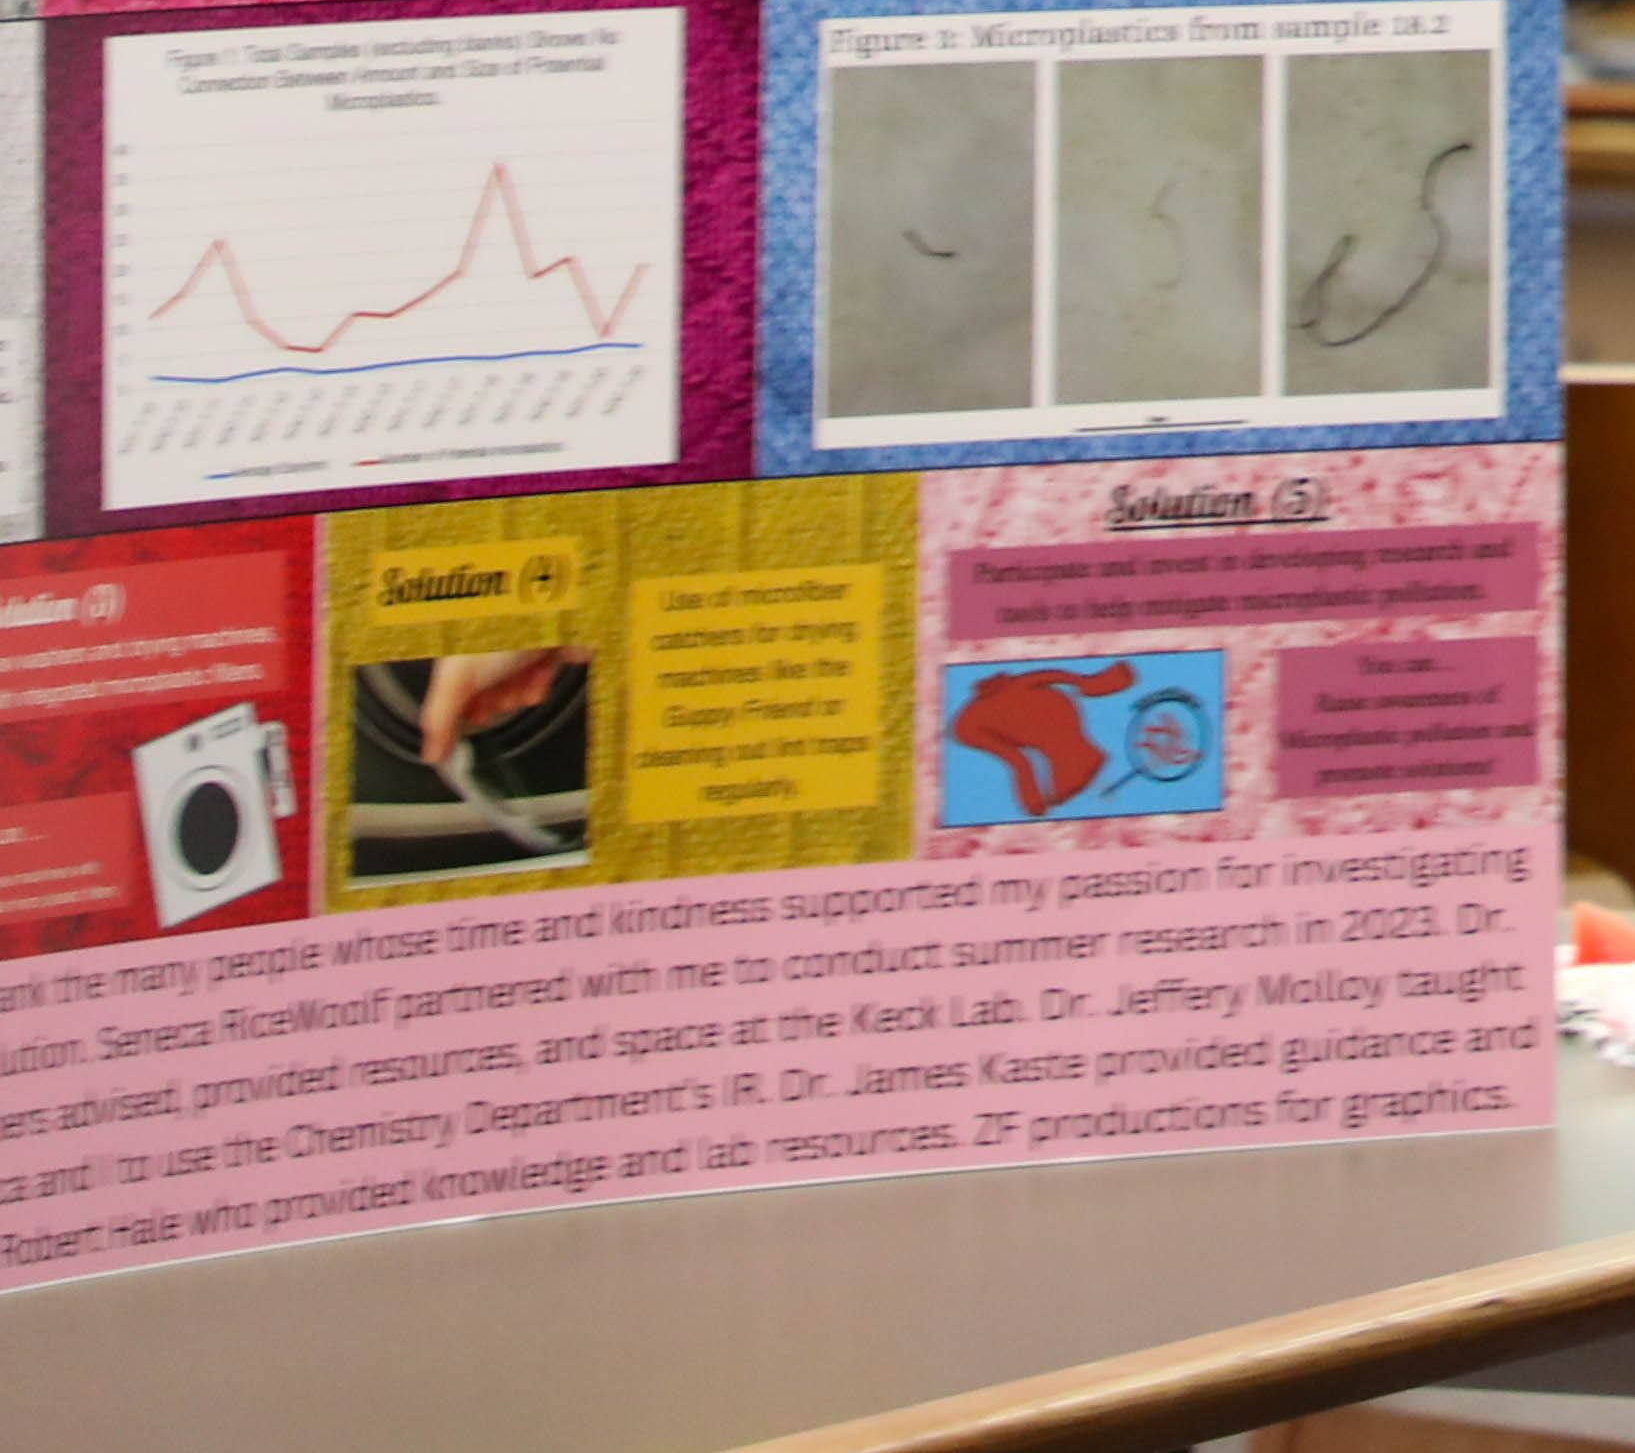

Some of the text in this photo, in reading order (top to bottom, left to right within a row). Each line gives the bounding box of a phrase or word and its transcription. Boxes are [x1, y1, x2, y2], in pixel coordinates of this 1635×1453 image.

[827, 25, 925, 60] Figure
[968, 16, 1179, 52] Microplastics
[1187, 14, 1265, 42] from
[1271, 11, 1383, 44] sample
[374, 559, 513, 606] Solution
[1104, 484, 1254, 524] Solution
[53, 843, 1533, 1004] the many people whose time and kindness supported my passion for investigating
[96, 1019, 214, 1062] Seneca
[393, 966, 575, 1030] partnered
[579, 959, 660, 1000] with
[665, 959, 729, 991] me
[732, 952, 776, 986] to
[782, 939, 943, 982] conduct
[949, 932, 1112, 970] summer
[1117, 914, 1289, 956] research
[1294, 910, 1333, 946] in
[1339, 905, 1449, 943] 2023.
[1455, 901, 1517, 935] Dr.
[34, 1155, 96, 1196] and
[115, 1148, 154, 1186] to
[159, 1144, 218, 1179] use
[221, 1130, 280, 1170] the
[285, 1109, 460, 1161] Chemistry
[465, 1077, 716, 1137] Department's
[780, 1067, 841, 1104] Dr.
[844, 1060, 973, 1097] James
[977, 1050, 1089, 1088] Kaste
[1094, 1036, 1274, 1086] provided
[1279, 1025, 1460, 1075] guidance
[1462, 1014, 1541, 1055] and
[57, 960, 1527, 1132] advised, provided resources, and space at the Keck Lab. Dr. Jeffery Molloy taught
[1, 1079, 1518, 1269] Robert Hale who provided knowledge and lab resources. ZF productions for graphics.
